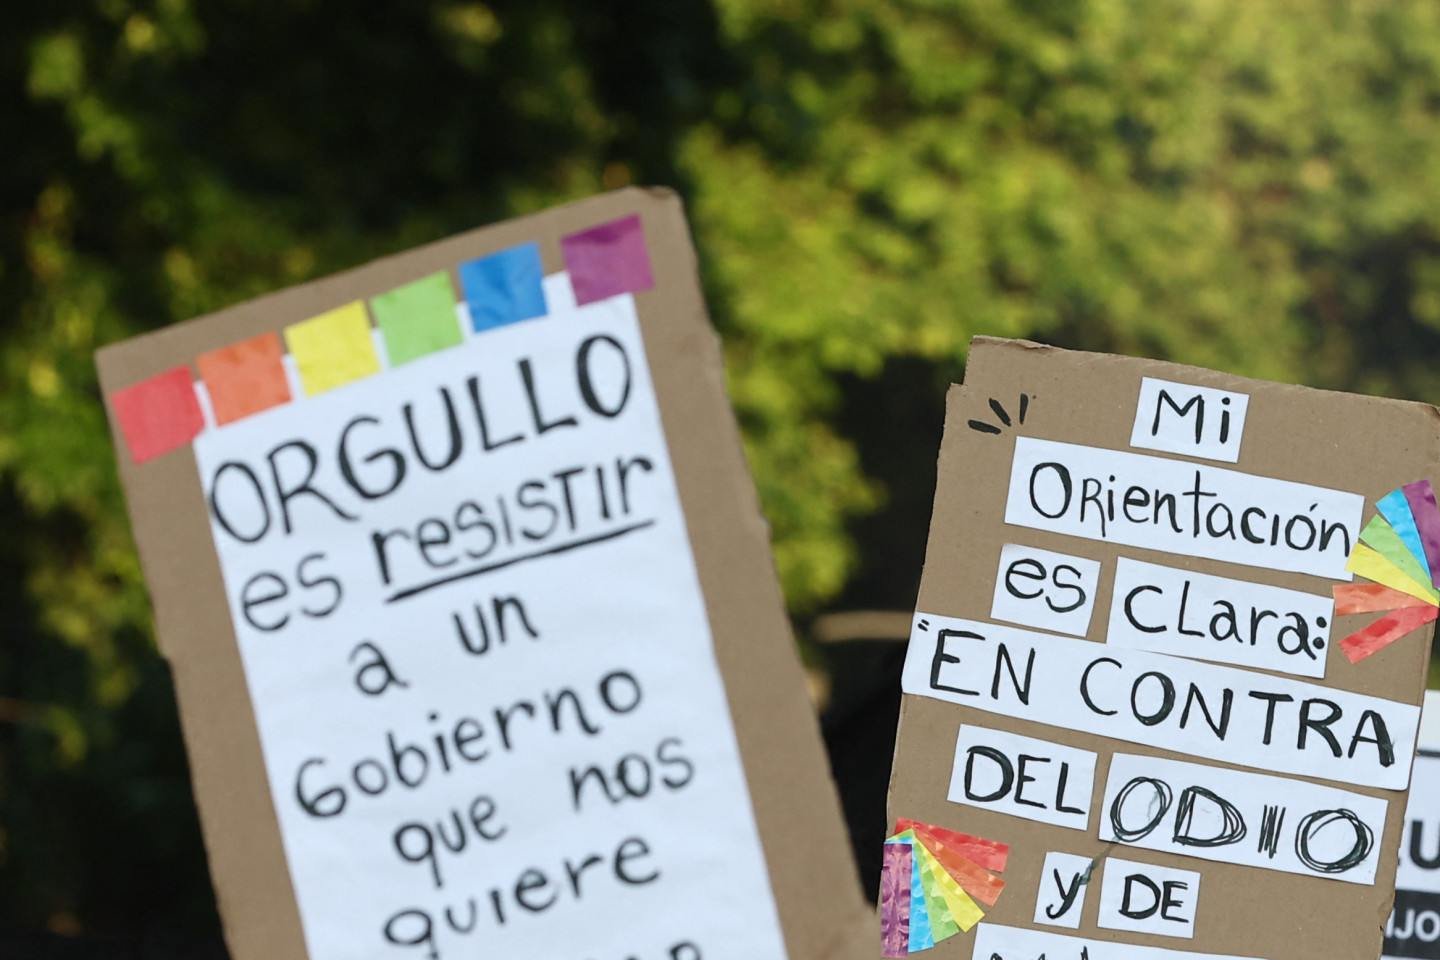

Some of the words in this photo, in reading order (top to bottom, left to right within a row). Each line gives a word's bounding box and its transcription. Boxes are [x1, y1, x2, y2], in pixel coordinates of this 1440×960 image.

[207, 333, 633, 545] ORGULLO
[1151, 389, 1232, 446] Mi
[239, 550, 345, 633] es
[1004, 556, 1088, 614] es
[349, 639, 410, 697] a
[452, 593, 540, 656] un
[1079, 656, 1396, 768] CONTRA
[392, 794, 511, 888] que
[567, 736, 697, 812] nos
[963, 744, 1087, 815] DEL
[1109, 775, 1374, 874] ODIO
[1117, 873, 1190, 924] DE
